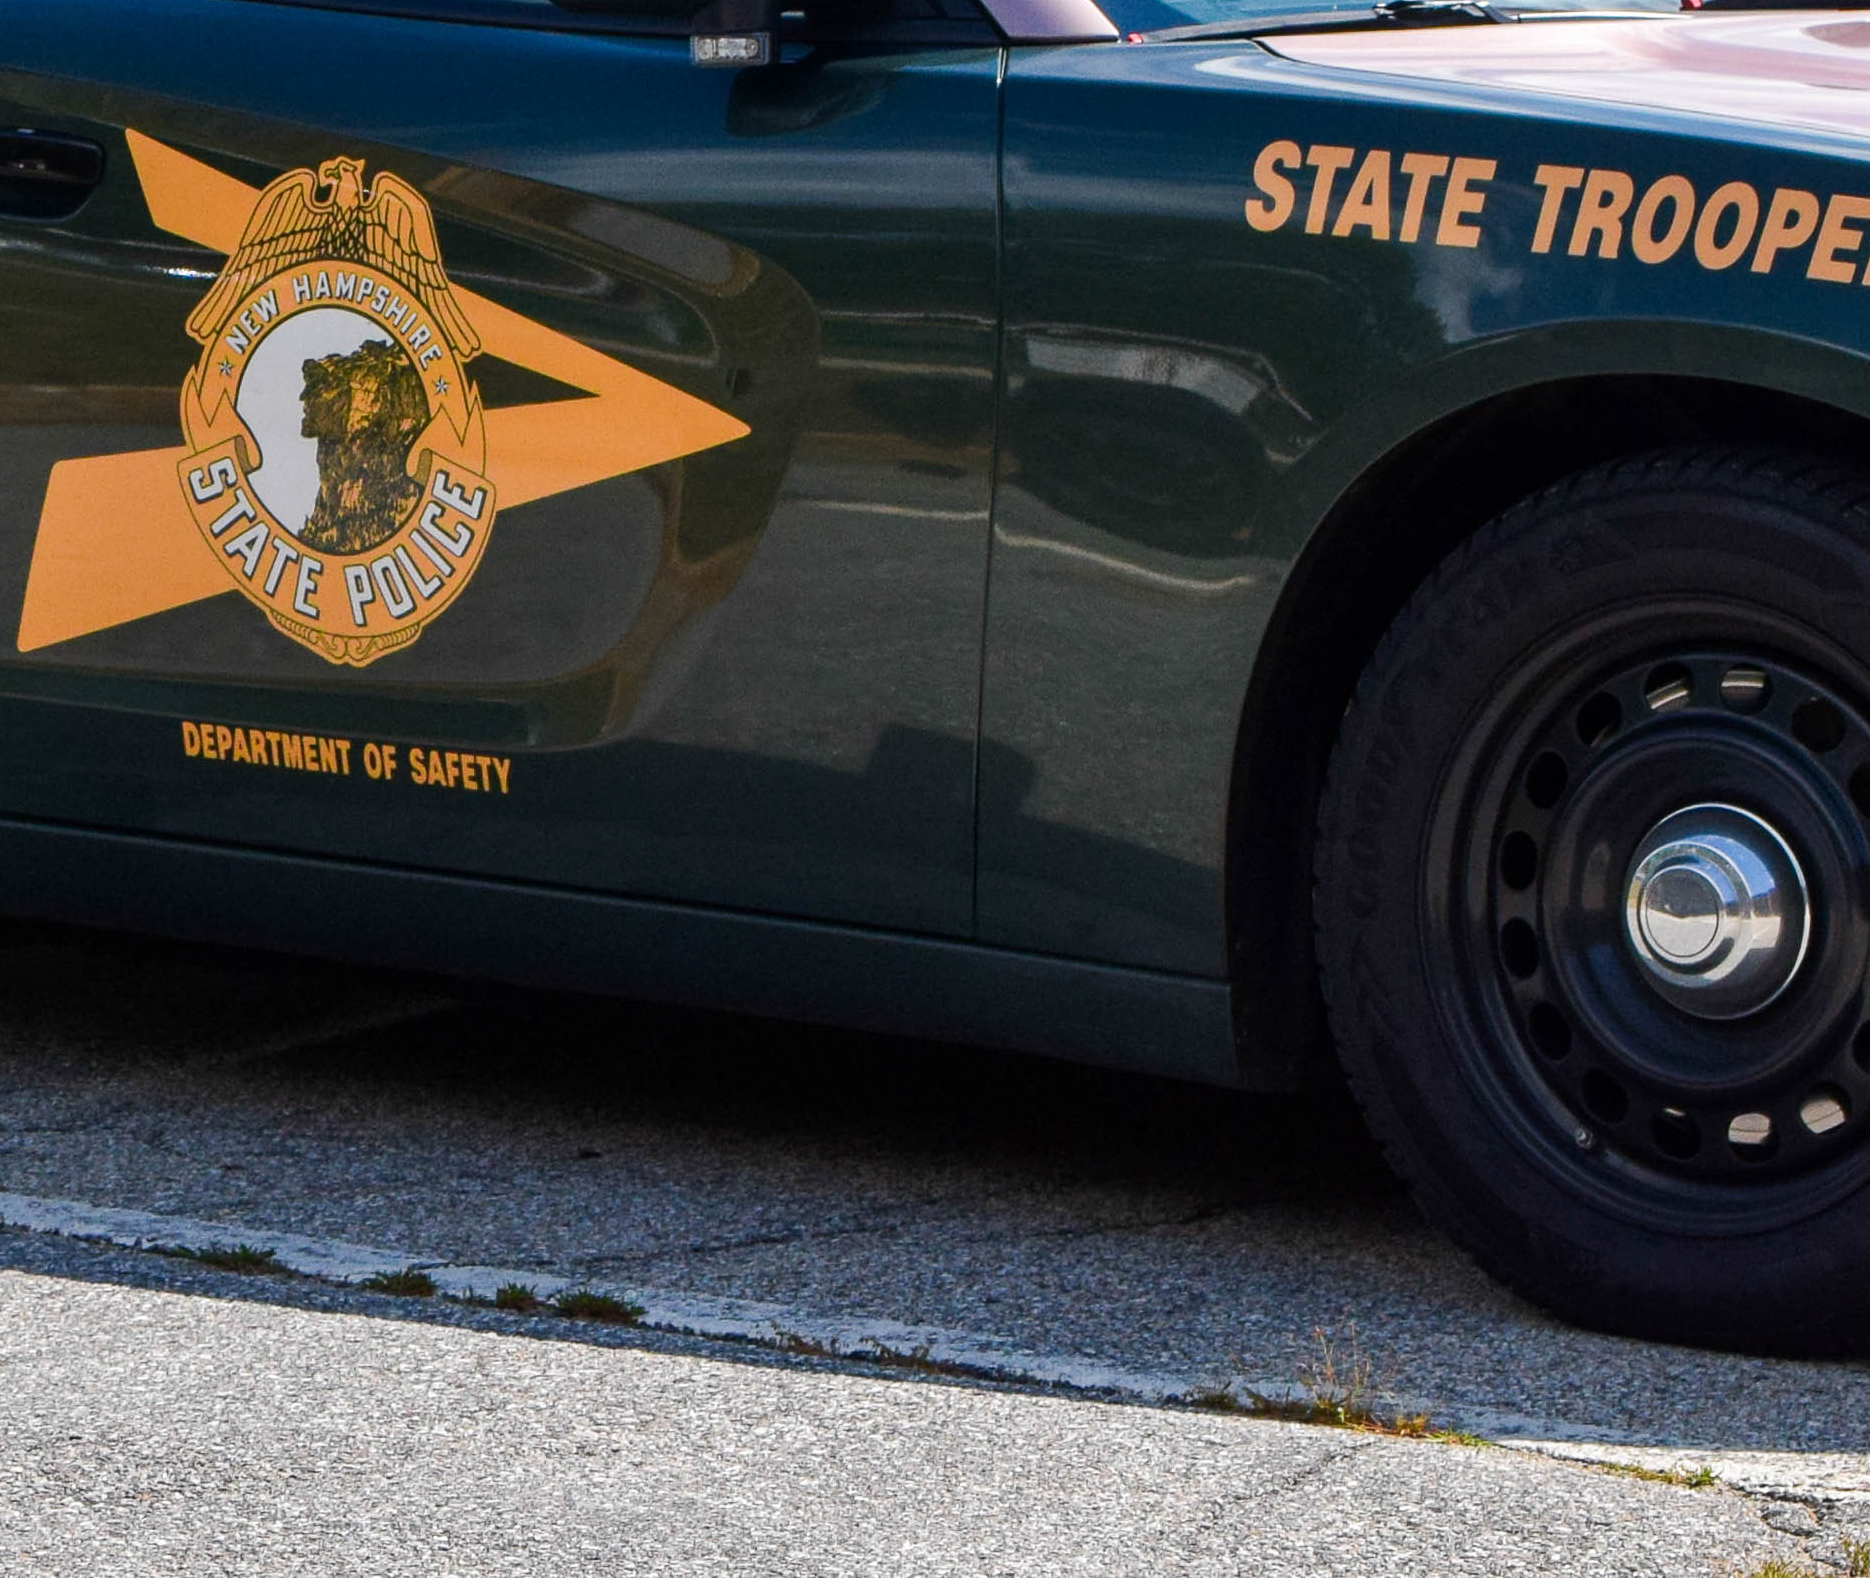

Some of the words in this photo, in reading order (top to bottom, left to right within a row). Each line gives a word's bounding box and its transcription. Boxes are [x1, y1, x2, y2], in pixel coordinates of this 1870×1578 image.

[1244, 139, 1497, 248] STATE
[225, 289, 280, 355] NEW
[292, 270, 442, 369] HAMPSHIRE
[188, 456, 324, 619] STATE
[343, 469, 488, 627] POLICE
[182, 721, 351, 776] DEPARTMENT
[363, 743, 397, 780] OF
[409, 747, 512, 795] SAFETY
